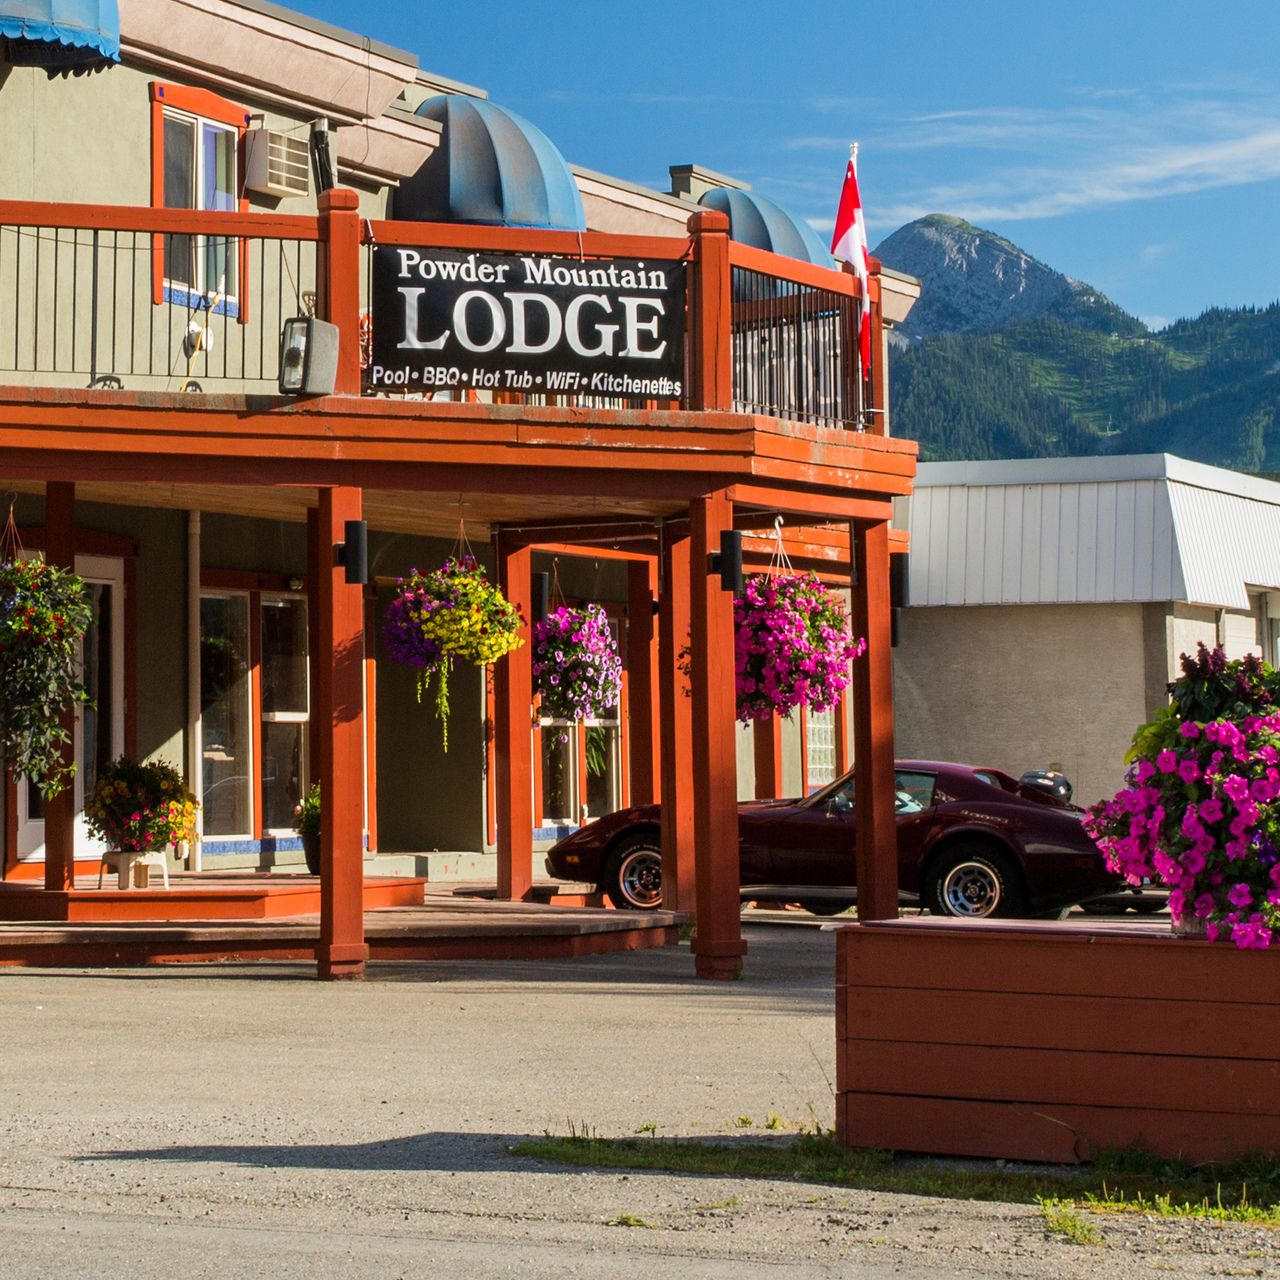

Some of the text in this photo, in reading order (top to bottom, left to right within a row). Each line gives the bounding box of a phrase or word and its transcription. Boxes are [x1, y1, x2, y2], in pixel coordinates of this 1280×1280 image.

[396, 249, 668, 290] Powder Mountain
[397, 286, 667, 359] LODGE
[472, 369, 500, 387] Hot
[591, 373, 682, 396] Kitchenettes
